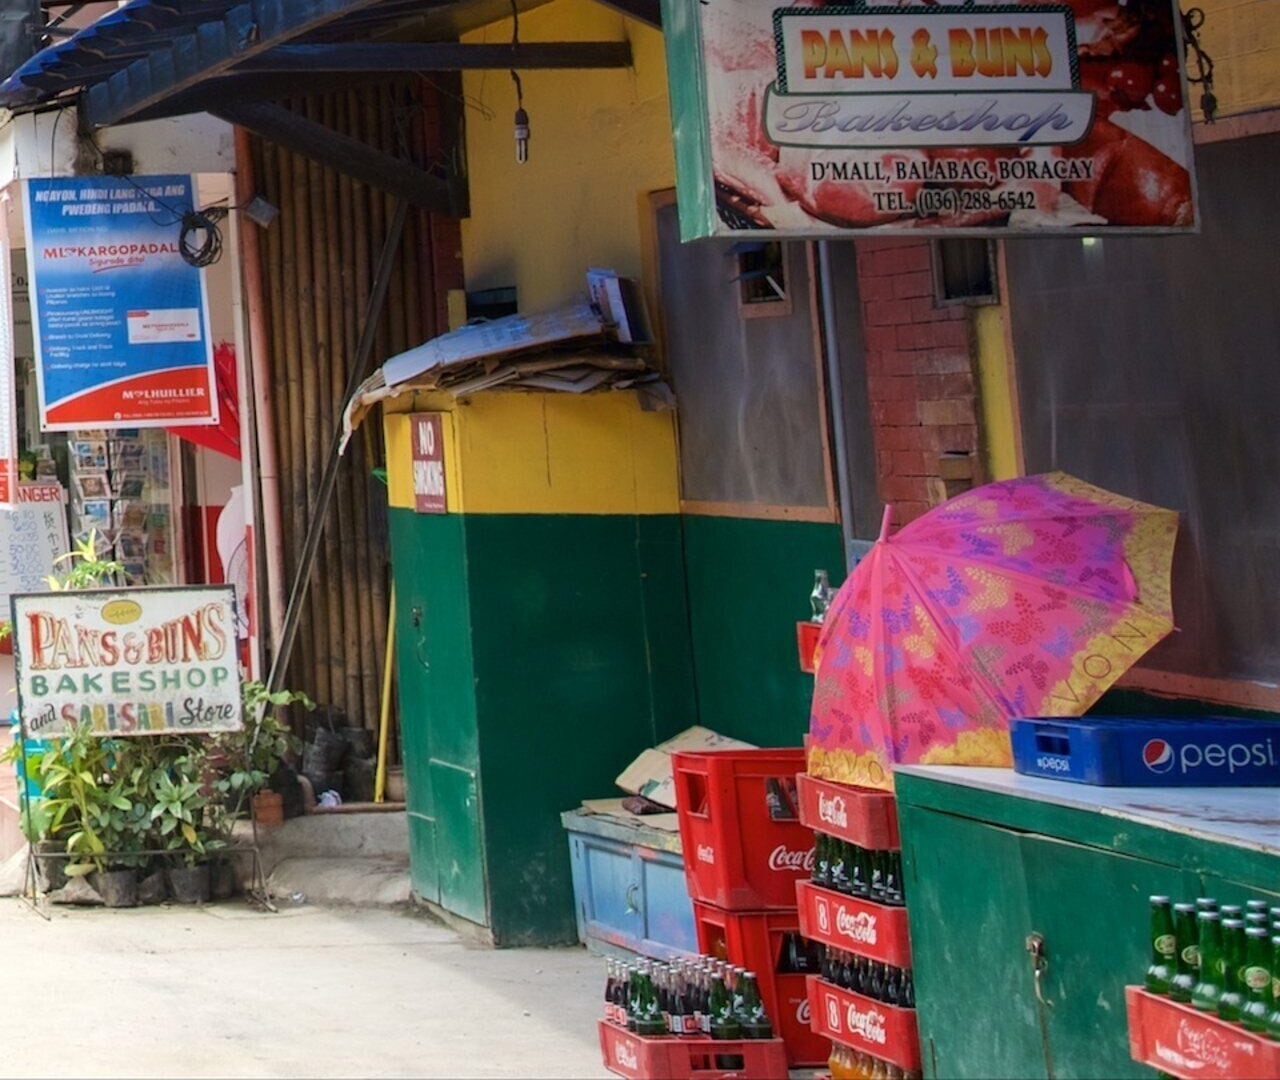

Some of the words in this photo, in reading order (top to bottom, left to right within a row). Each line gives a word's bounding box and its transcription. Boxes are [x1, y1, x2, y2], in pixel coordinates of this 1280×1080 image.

[801, 27, 899, 80] PANS
[909, 27, 938, 79] &
[948, 26, 1053, 78] BUNS
[775, 98, 1075, 142] Bakeshop
[896, 160, 994, 183] BALABAG,
[999, 159, 1095, 180] BORACAY
[80, 187, 108, 201] HINDI
[110, 187, 135, 200] LANG
[165, 184, 185, 196] ANG
[873, 192, 913, 211] TEL.
[917, 191, 961, 213] (036)
[962, 191, 1036, 211] 288-6542
[62, 203, 111, 216] PWEDENG
[77, 243, 182, 257] KARGOPADAL
[419, 421, 434, 455] NO
[414, 461, 444, 495] SMOKING
[25, 610, 121, 670] PANS
[123, 631, 145, 666] &
[145, 601, 227, 666] BUNS
[30, 666, 229, 697] BAKESHOP
[30, 703, 56, 732] and
[180, 697, 235, 725] Store
[1180, 738, 1274, 773] pepsi
[818, 899, 828, 928] 8
[828, 997, 838, 1026] 8
